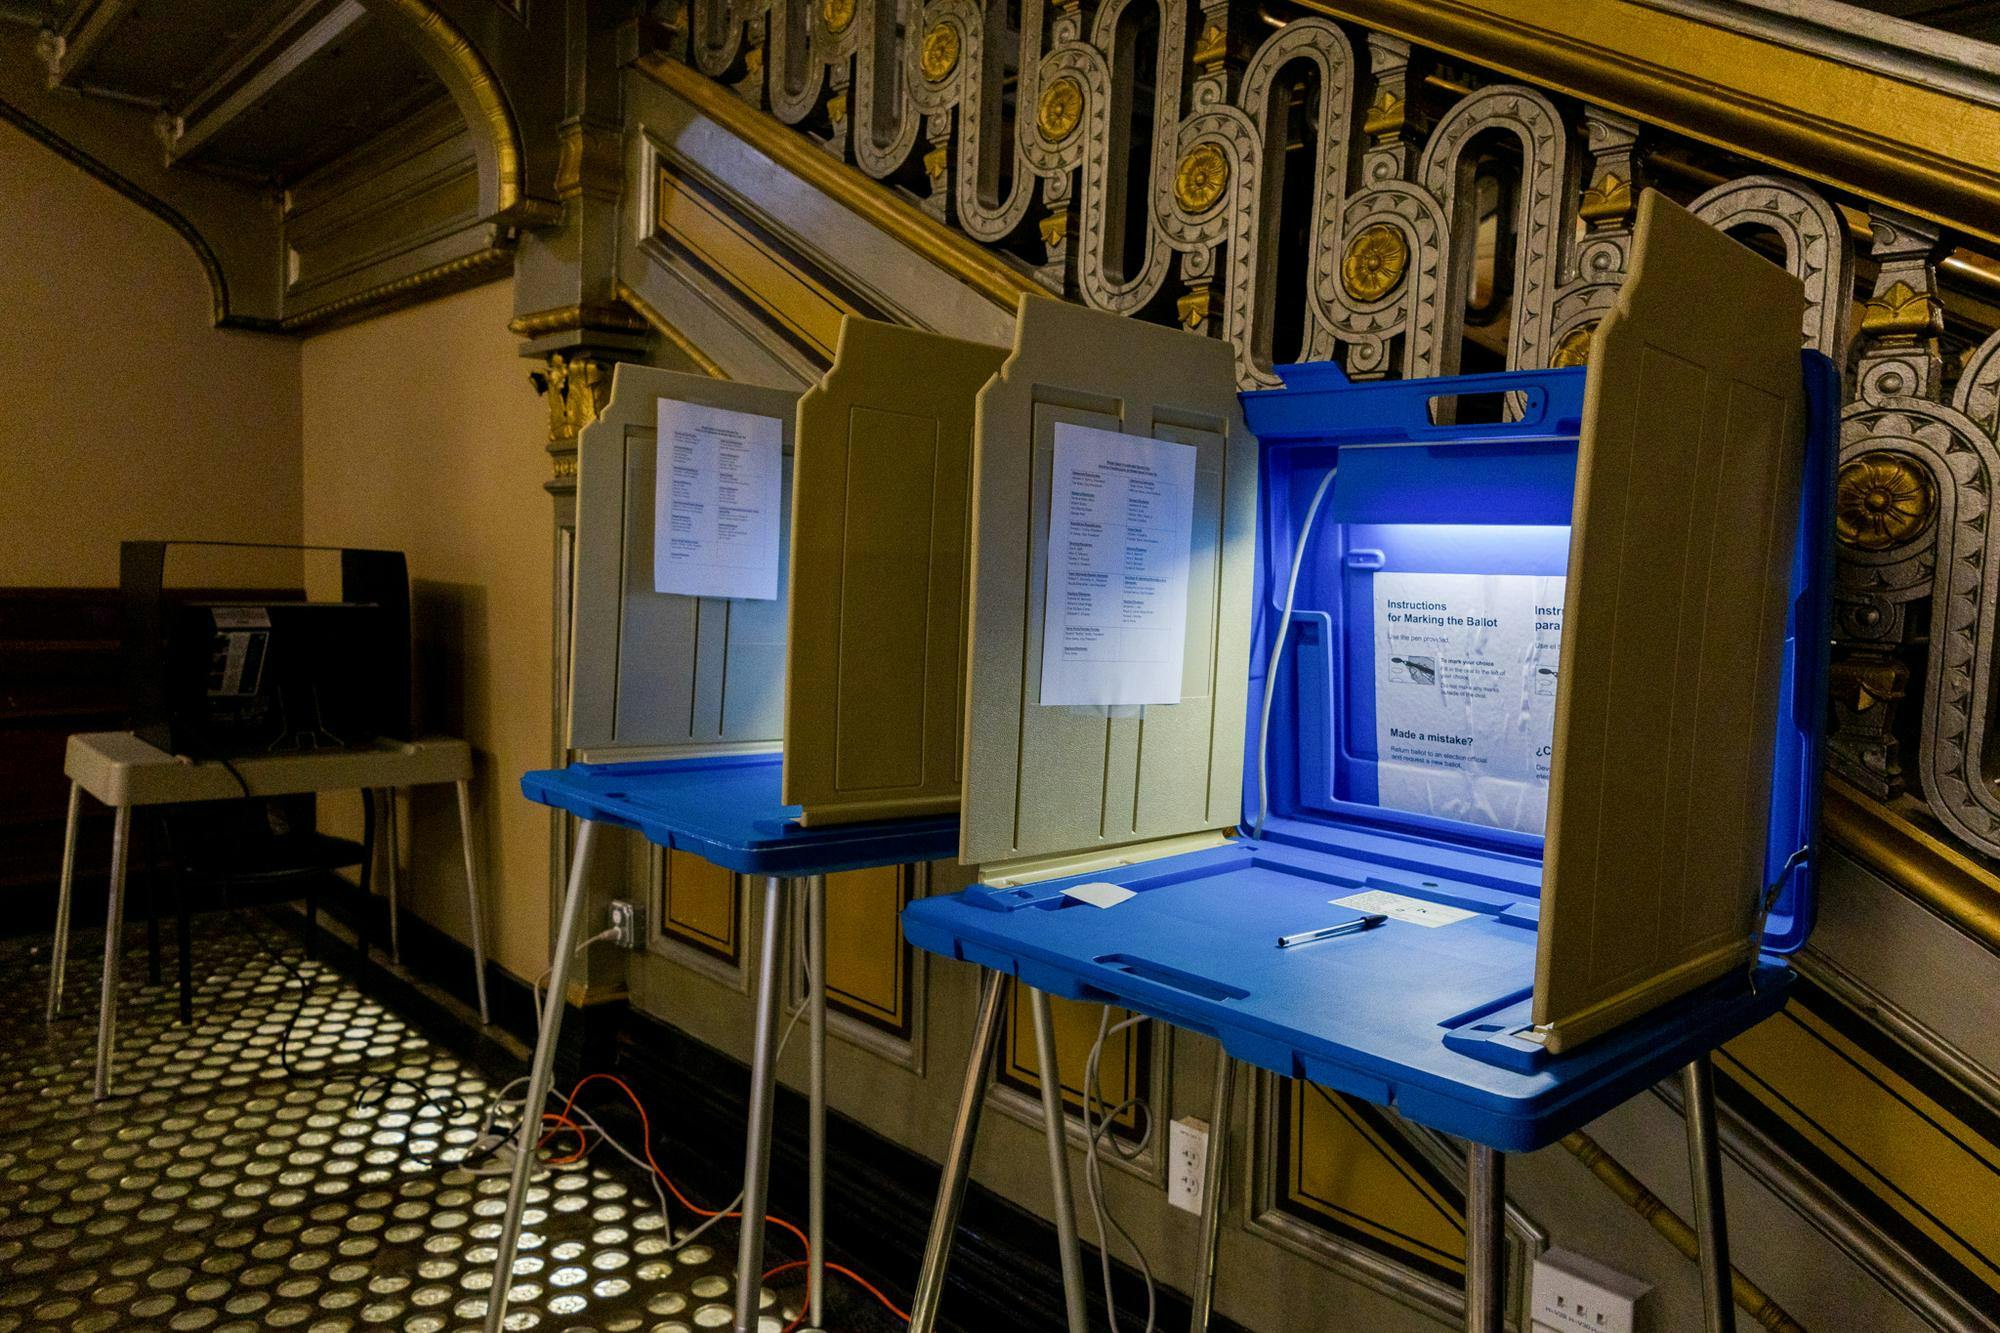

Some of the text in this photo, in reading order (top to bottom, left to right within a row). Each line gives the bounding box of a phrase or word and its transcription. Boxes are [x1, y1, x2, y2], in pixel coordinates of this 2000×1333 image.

[1387, 599, 1447, 611] Instructions
[1535, 605, 1562, 616] Instr
[1387, 612, 1498, 627] for Marking the Ballot
[1535, 622, 1560, 632] para
[1390, 727, 1473, 746] Made a mistake?
[1390, 745, 1410, 755] Return
[1410, 747, 1427, 756] ballot
[1443, 752, 1466, 760] election
[1535, 745, 1551, 757] ¿C
